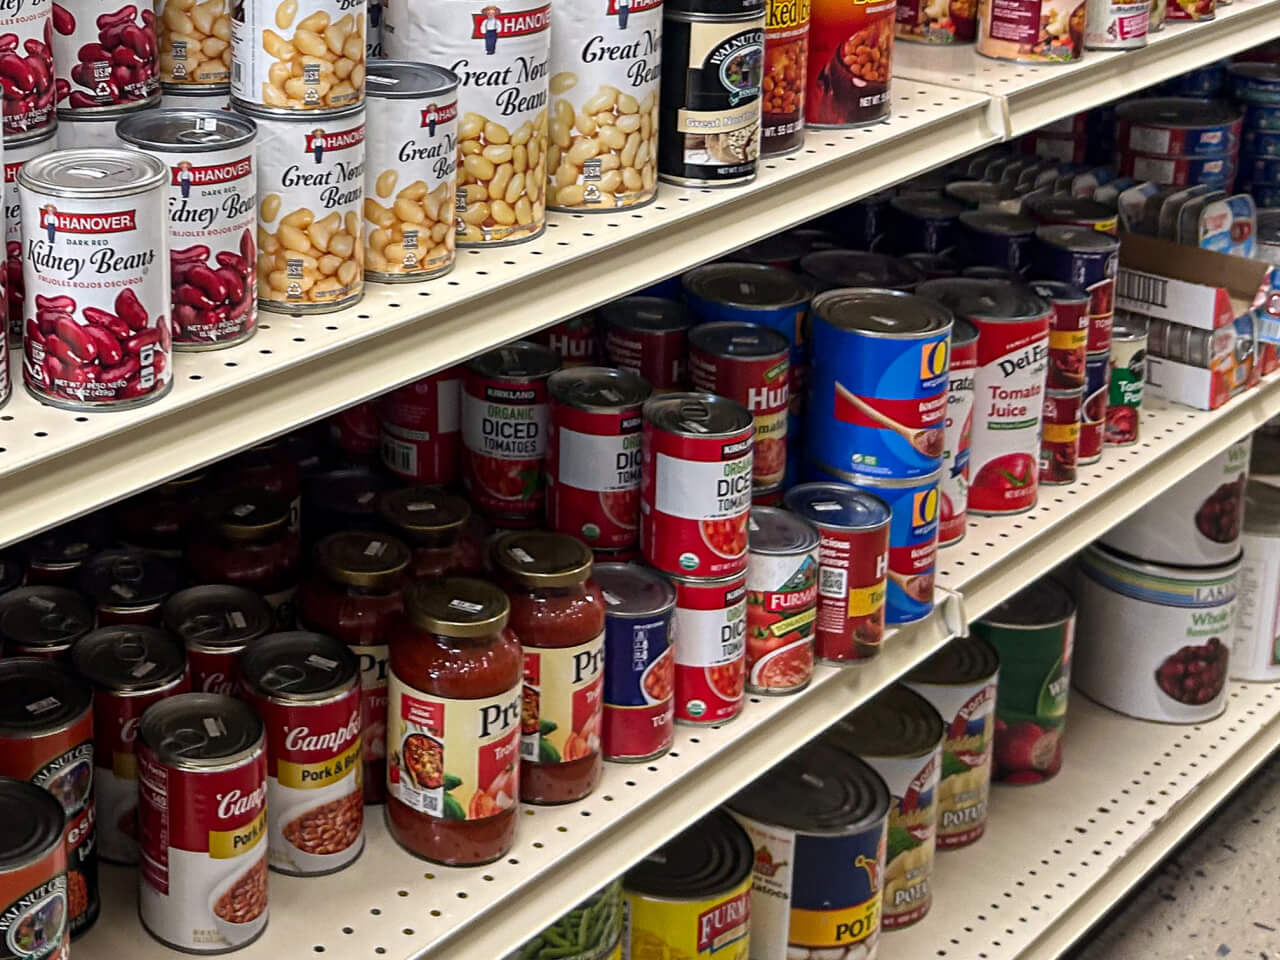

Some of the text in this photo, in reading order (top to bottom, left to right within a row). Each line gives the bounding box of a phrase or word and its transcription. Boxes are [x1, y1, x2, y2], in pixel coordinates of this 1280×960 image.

[582, 36, 639, 63] Great
[282, 167, 331, 188] Great
[60, 216, 130, 230] HANOVER
[27, 240, 155, 280] Kidney Beans
[998, 355, 1031, 378] Dei
[487, 389, 535, 399] KIRKLAND
[988, 385, 1041, 399] Tomato
[487, 406, 534, 419] ORGANIC
[988, 403, 1027, 418] Juice
[482, 419, 538, 437] DICED
[484, 437, 536, 453] TOMATOES
[302, 765, 332, 782] Pork
